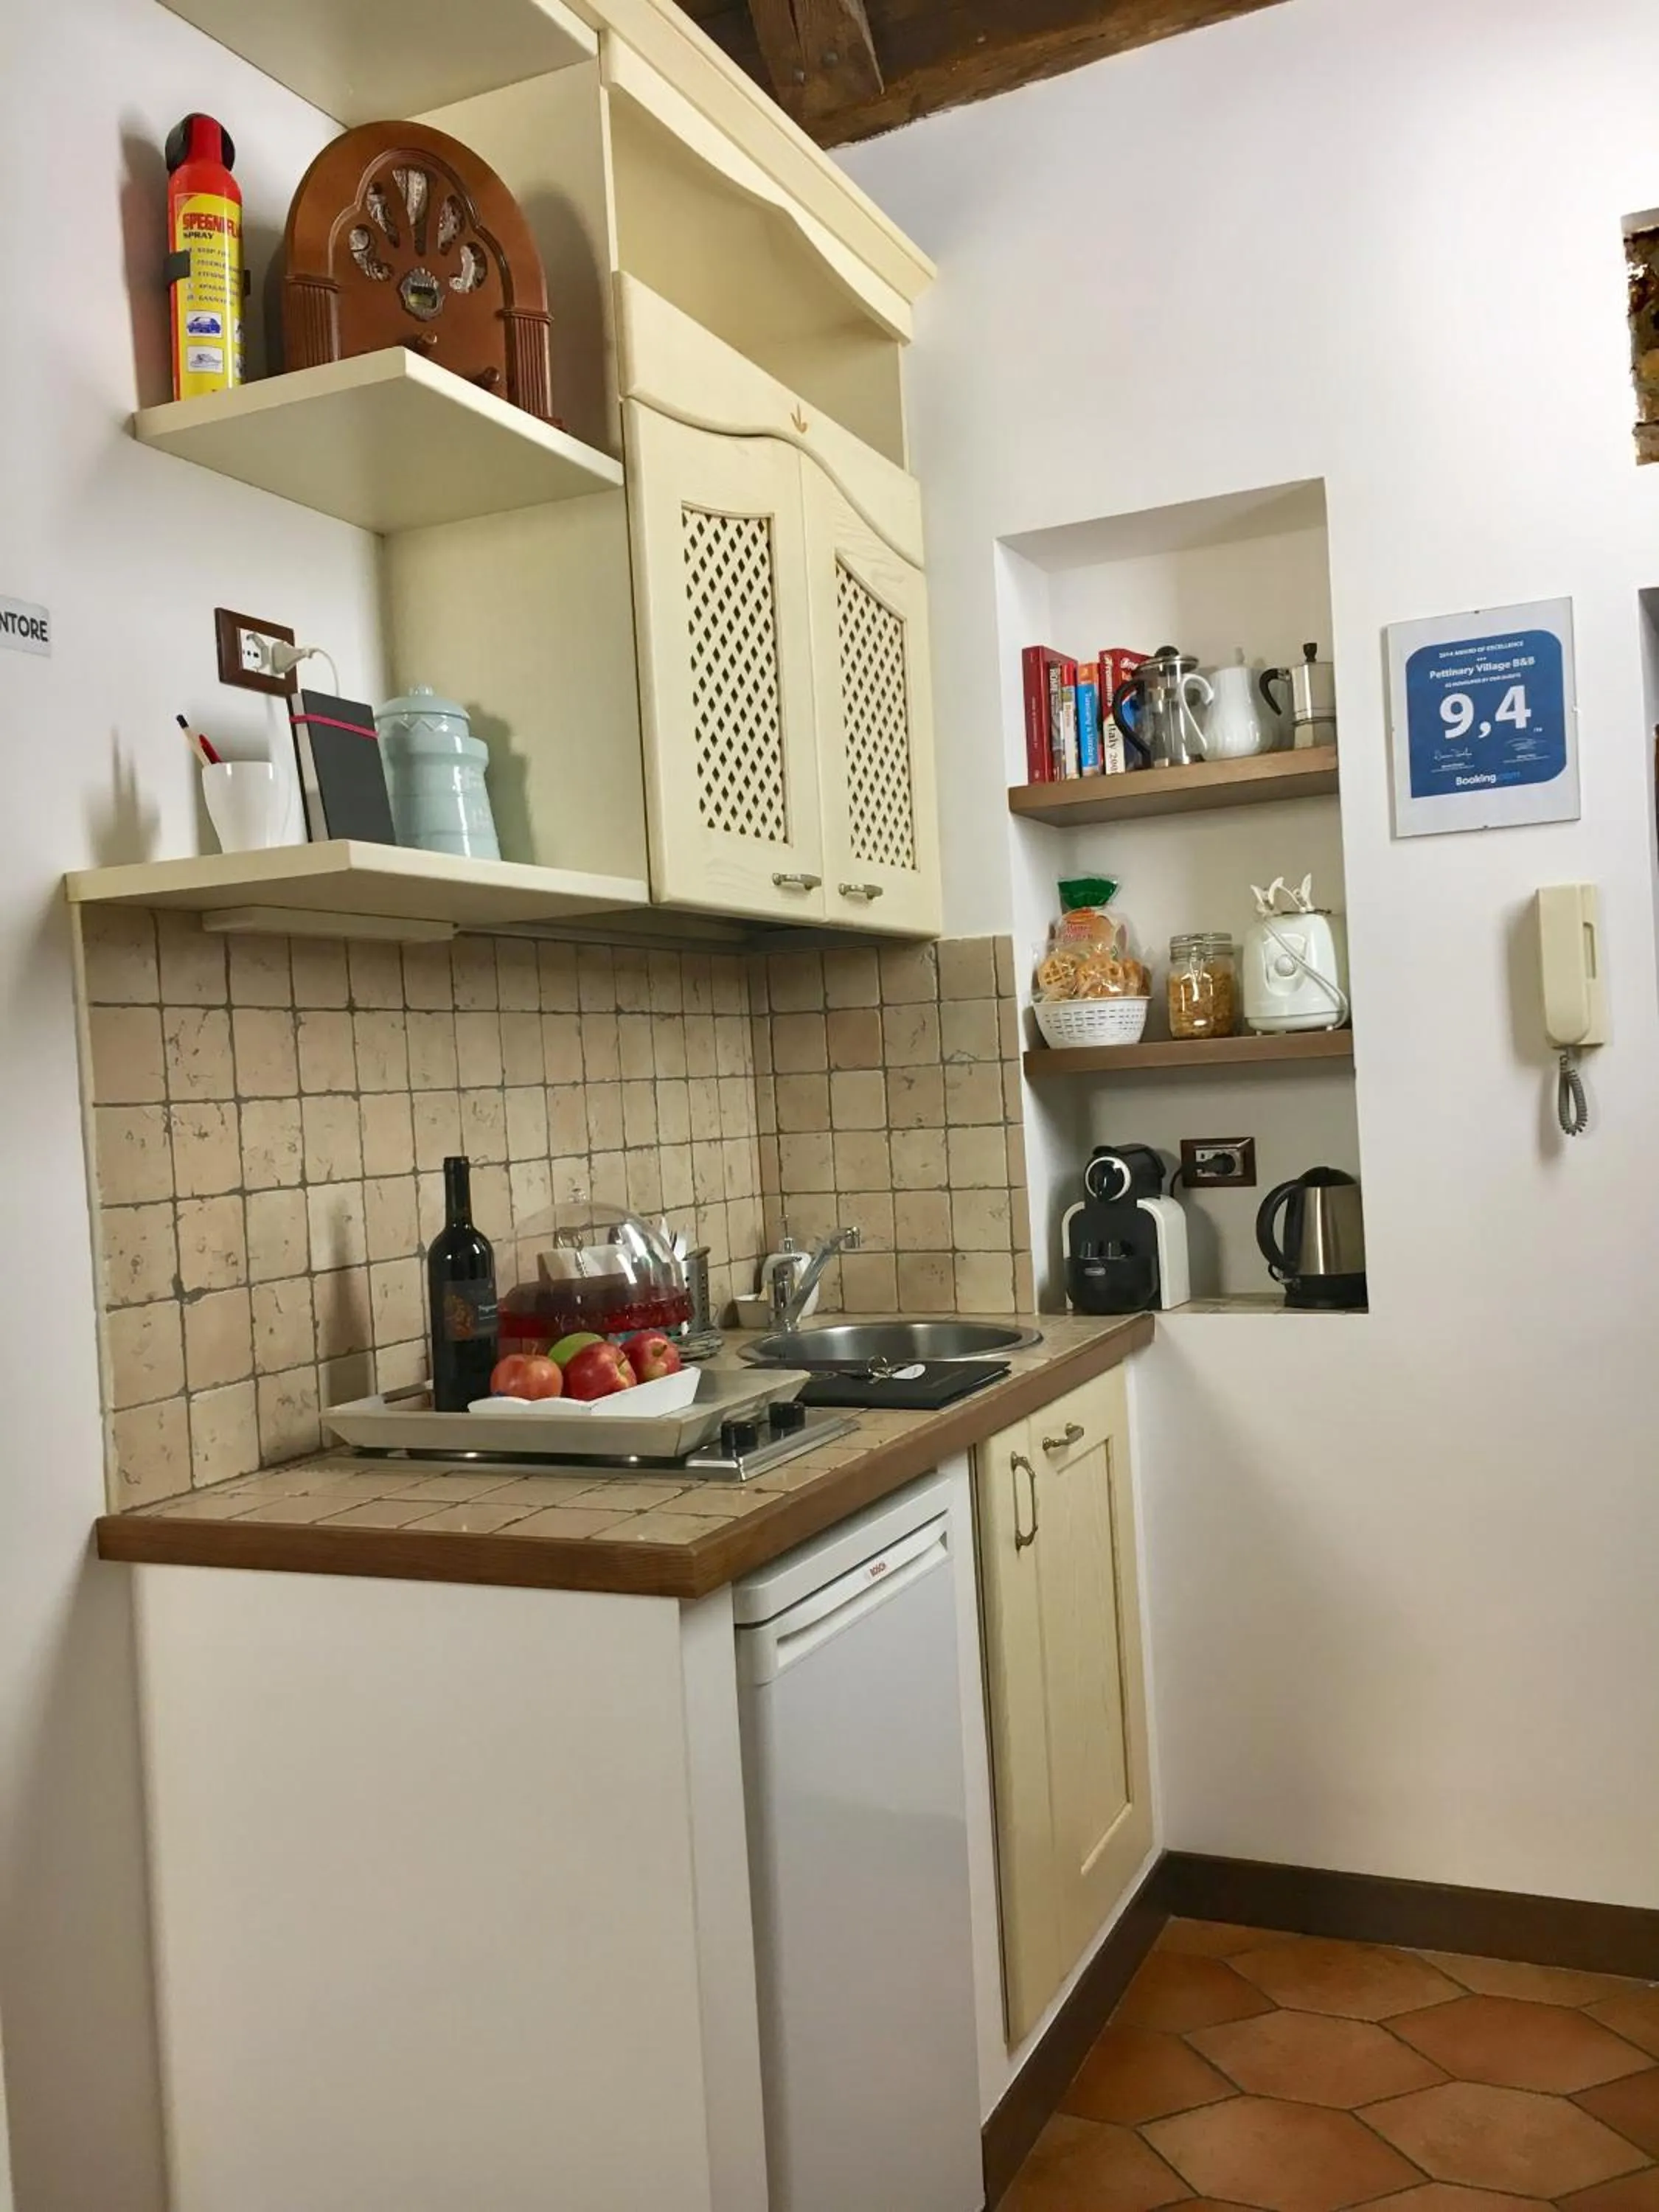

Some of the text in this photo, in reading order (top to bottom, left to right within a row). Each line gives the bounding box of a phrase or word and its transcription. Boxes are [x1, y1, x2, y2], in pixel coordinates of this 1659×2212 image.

[183, 231, 214, 240] SPRAY
[0, 611, 49, 643] NTORE
[1429, 655, 1535, 679] Pettinary Village B&B
[1439, 684, 1531, 739] 9,4
[1107, 723, 1119, 772] Italy 200
